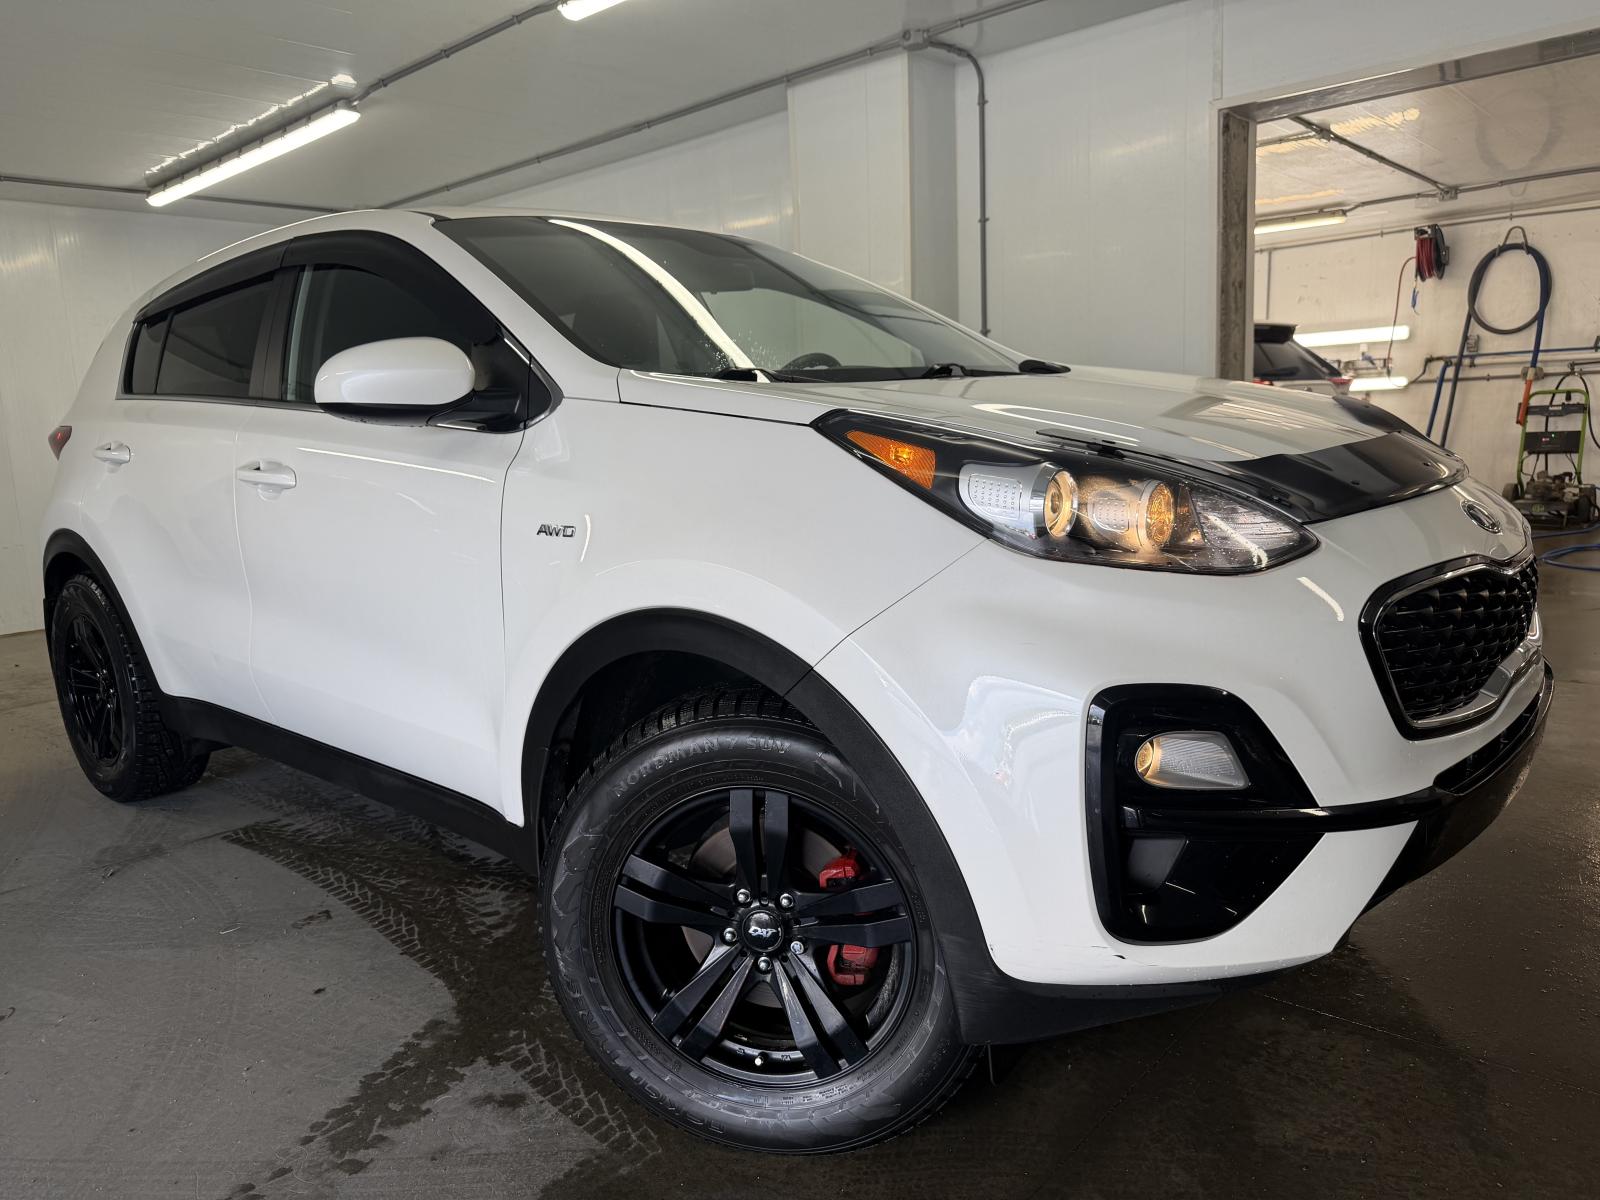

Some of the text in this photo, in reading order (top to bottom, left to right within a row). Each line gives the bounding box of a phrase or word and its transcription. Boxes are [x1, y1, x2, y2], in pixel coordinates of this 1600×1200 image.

[536, 524, 577, 538] AWD
[612, 737, 720, 797] NORDMAN
[746, 736, 791, 754] SUV
